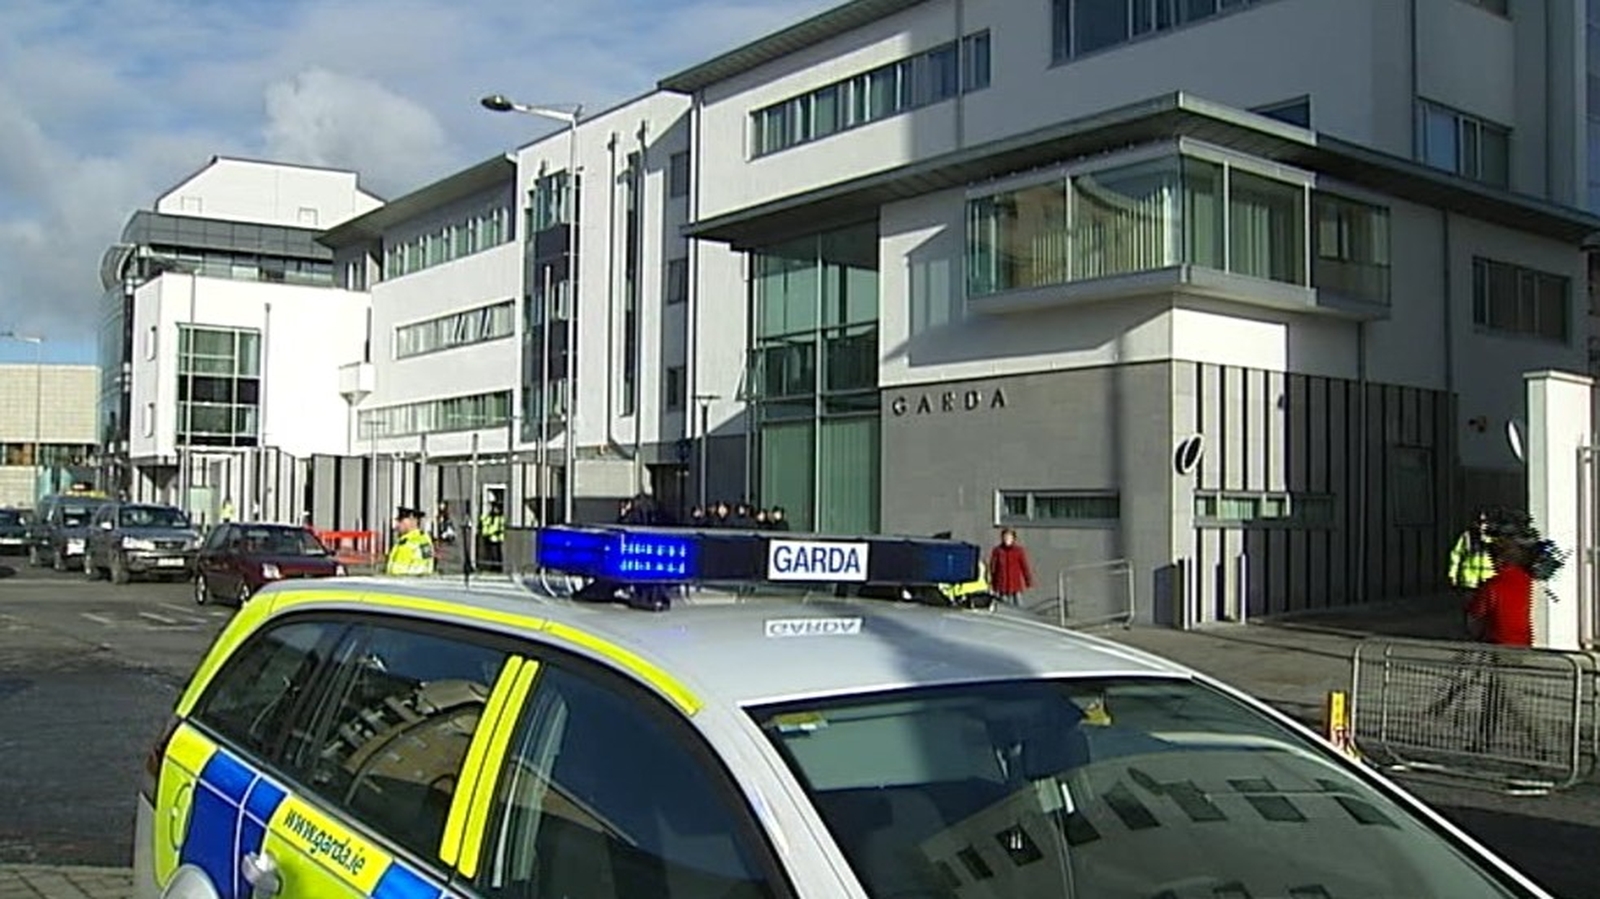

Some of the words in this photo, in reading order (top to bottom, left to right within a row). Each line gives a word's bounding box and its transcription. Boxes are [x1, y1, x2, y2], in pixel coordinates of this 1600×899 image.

[892, 387, 1006, 416] GARDA
[773, 545, 861, 573] GARDA
[283, 808, 366, 876] www.garda.ie
